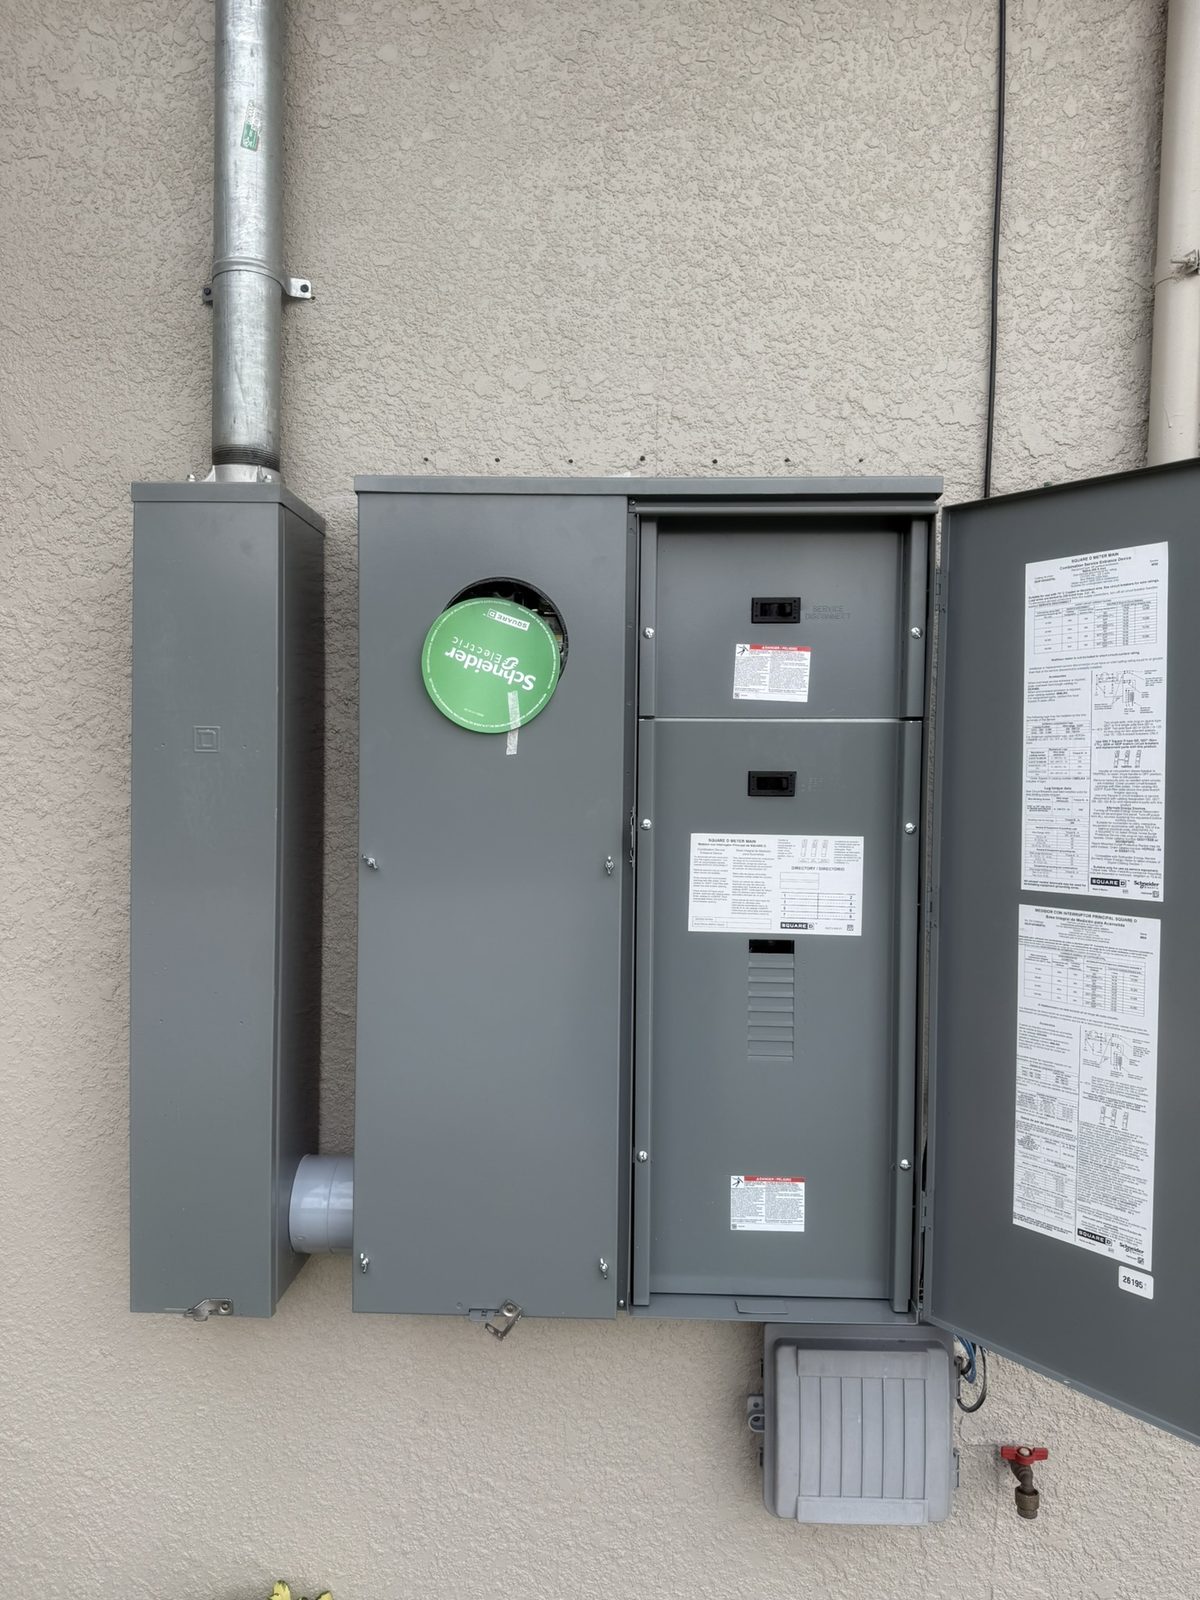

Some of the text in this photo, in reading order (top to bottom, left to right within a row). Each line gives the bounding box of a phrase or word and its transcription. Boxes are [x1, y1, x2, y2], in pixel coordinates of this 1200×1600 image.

[496, 613, 529, 629] SQUARE
[452, 636, 502, 664] Electric
[444, 646, 536, 691] Schneider
[1091, 878, 1119, 886] SQUARE
[1078, 1229, 1105, 1243] SQUARE
[1122, 1275, 1144, 1289] 26195
